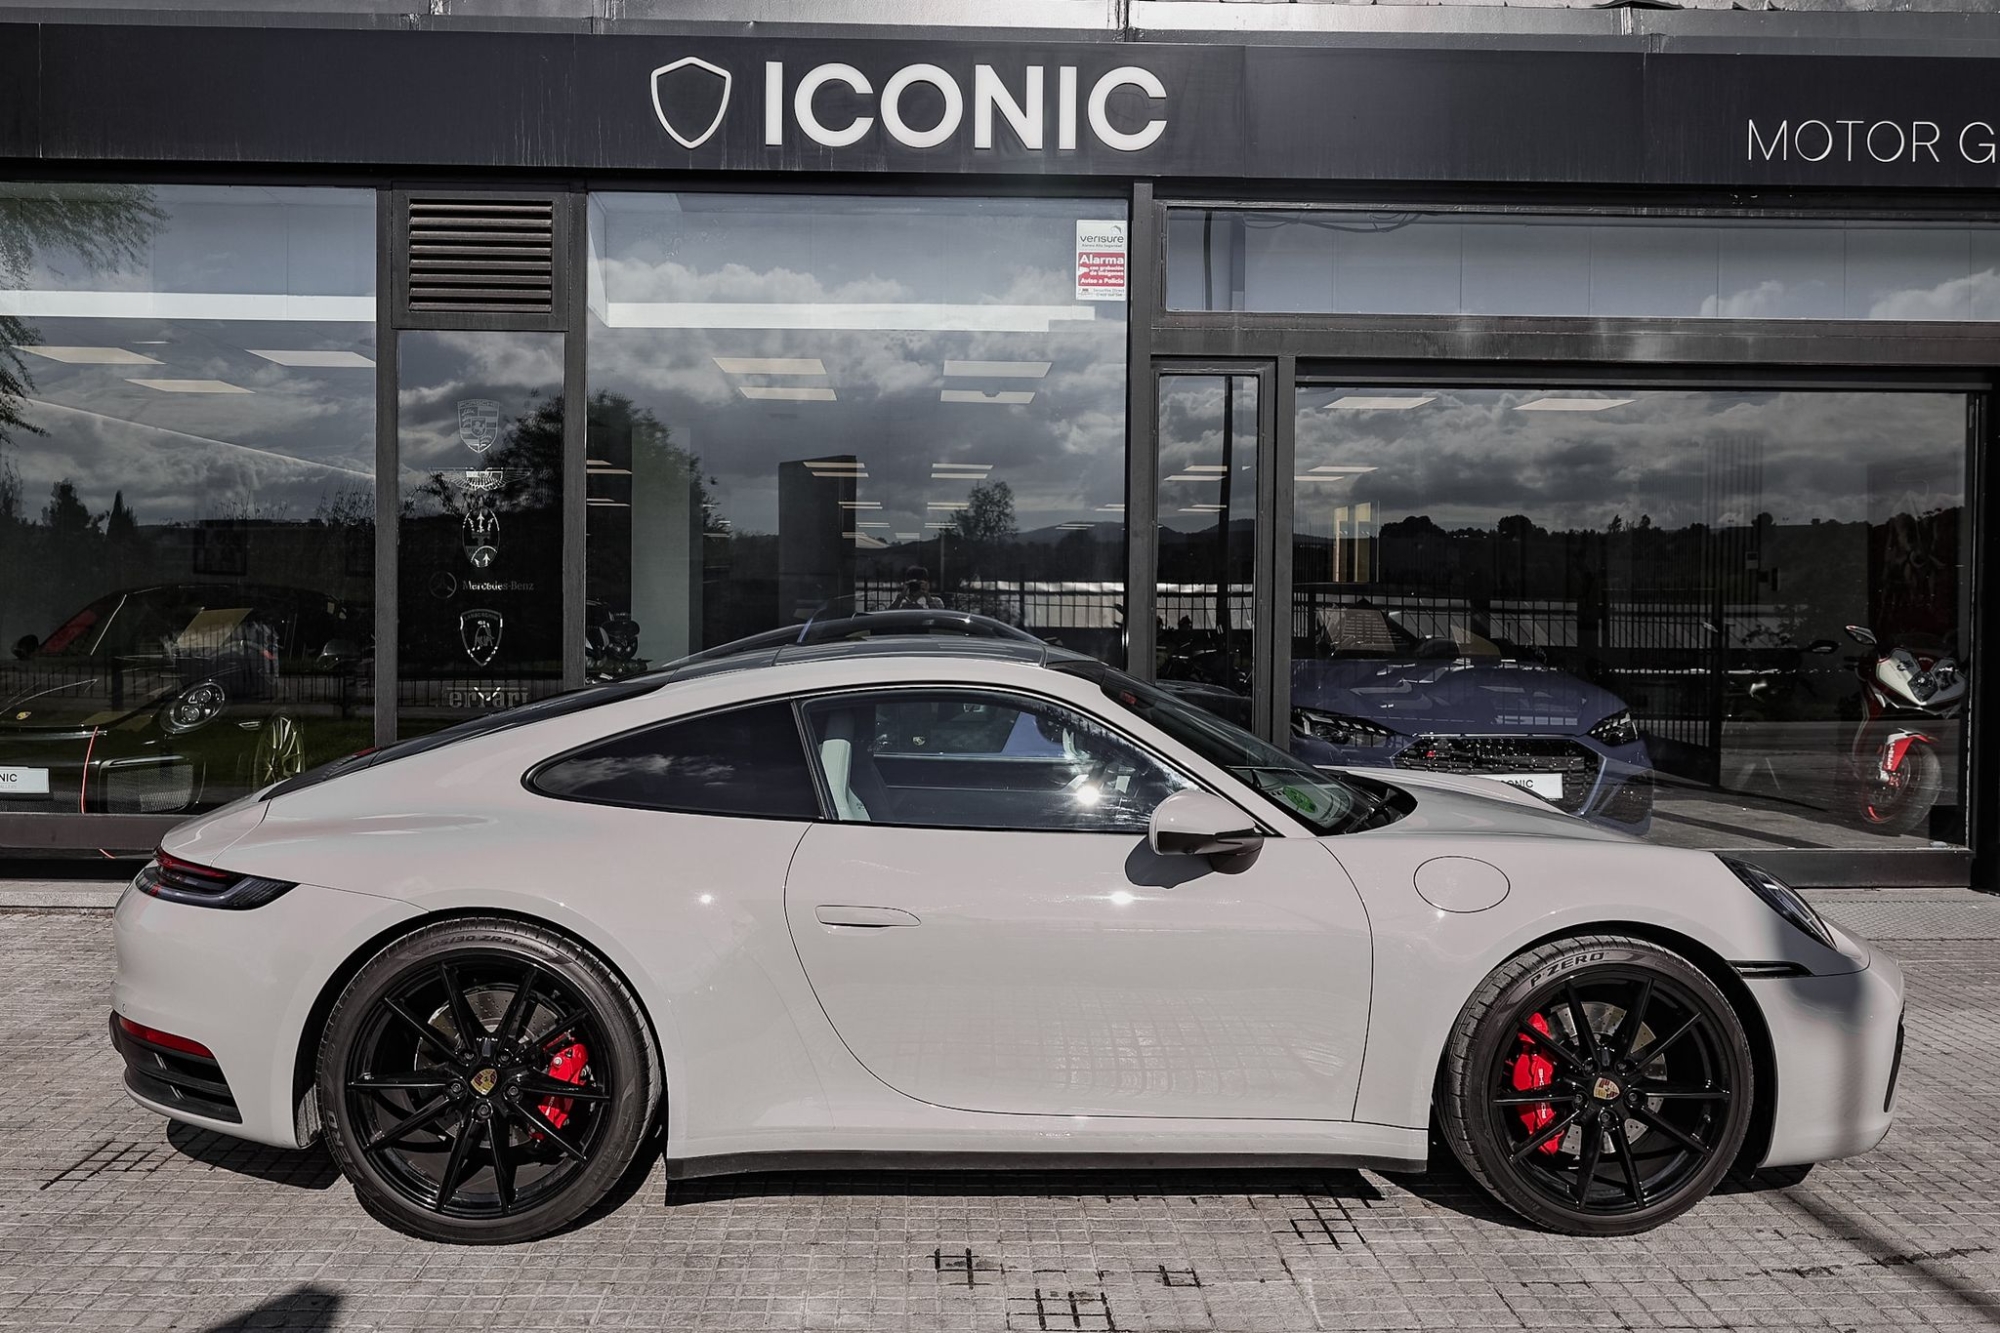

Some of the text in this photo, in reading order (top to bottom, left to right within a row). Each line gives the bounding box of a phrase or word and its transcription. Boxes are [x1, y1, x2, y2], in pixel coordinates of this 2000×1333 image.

[765, 61, 1168, 152] ICONIC
[1748, 119, 1996, 164] MOTOR G
[1080, 235, 1124, 243] verisure
[1080, 254, 1124, 264] Alarma
[462, 580, 535, 591] Mercedes-Benz
[1503, 779, 1534, 789] ONIC
